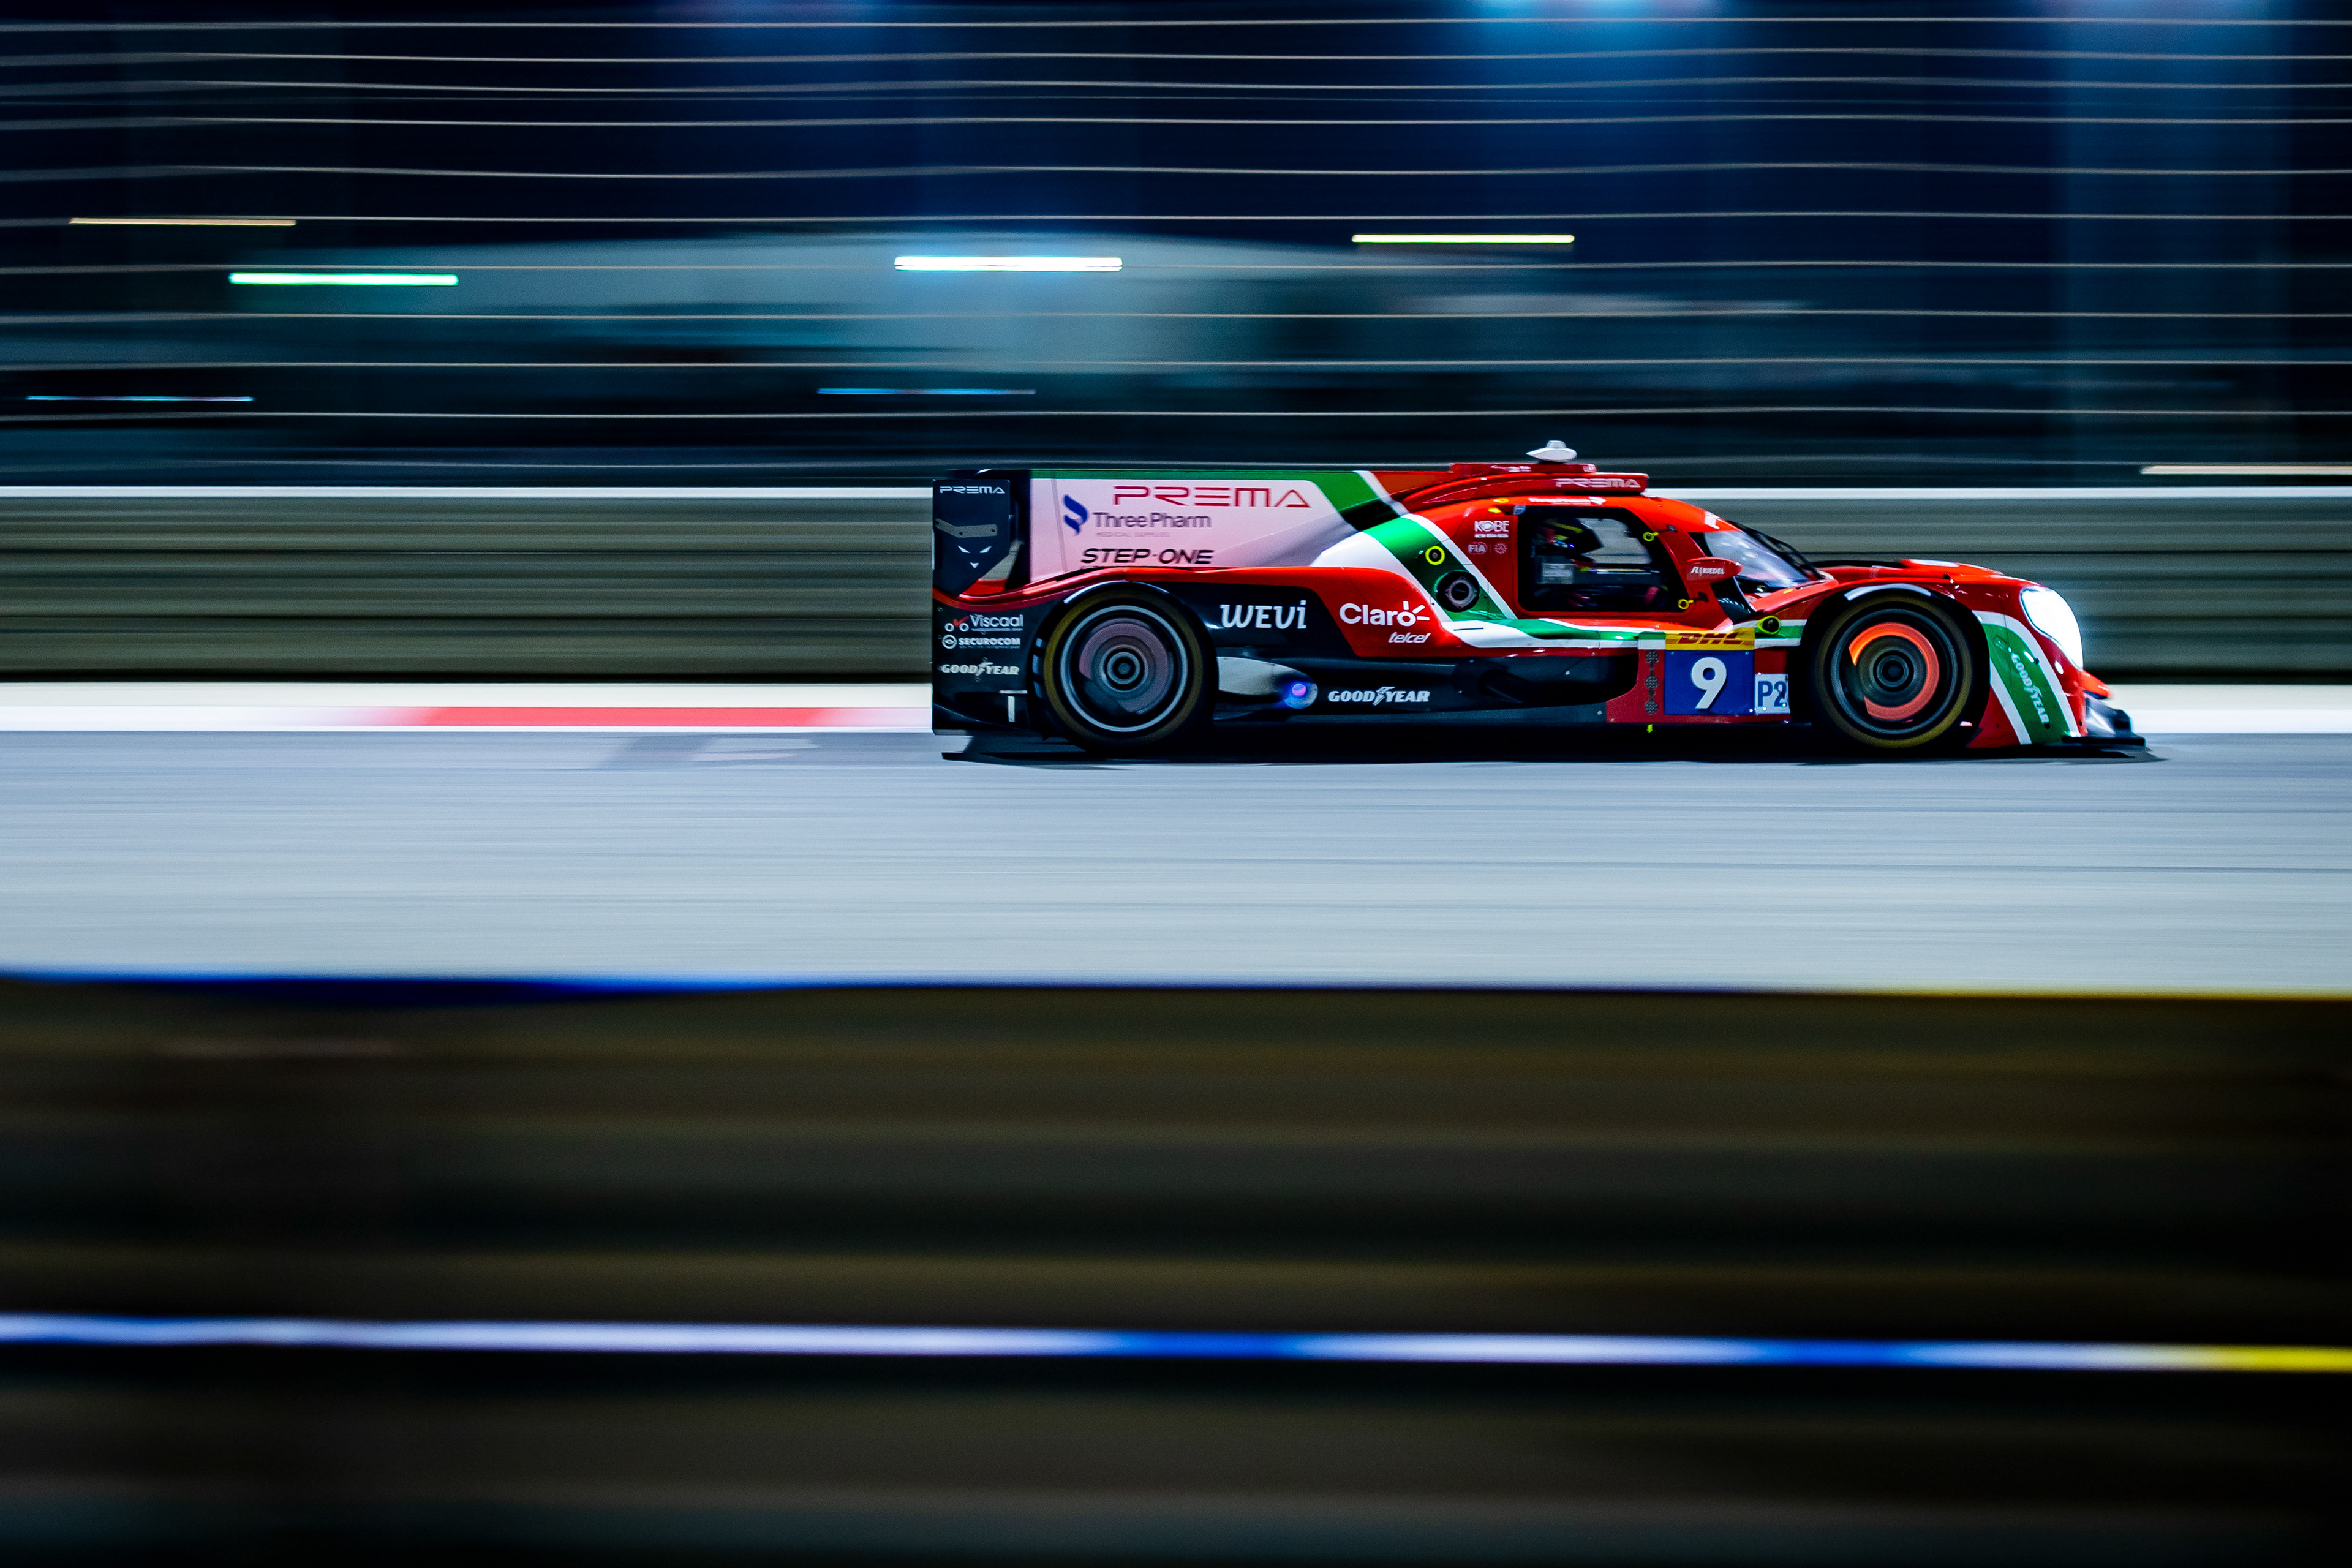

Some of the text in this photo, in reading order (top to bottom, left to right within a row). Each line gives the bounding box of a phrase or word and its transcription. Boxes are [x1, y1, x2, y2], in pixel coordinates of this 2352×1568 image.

[1555, 478, 1641, 488] PREMA
[1113, 486, 1311, 508] PREMA
[1093, 512, 1212, 527] Three Pharm
[1474, 520, 1510, 532] KOBE
[1468, 544, 1487, 552] FIA
[1081, 548, 1215, 564] STEP-ONE
[970, 614, 1023, 627] Viscaal
[1340, 602, 1417, 627] Claro
[1388, 631, 1431, 643] telcel
[1691, 657, 1727, 709] 9
[1757, 680, 1787, 707] P2
